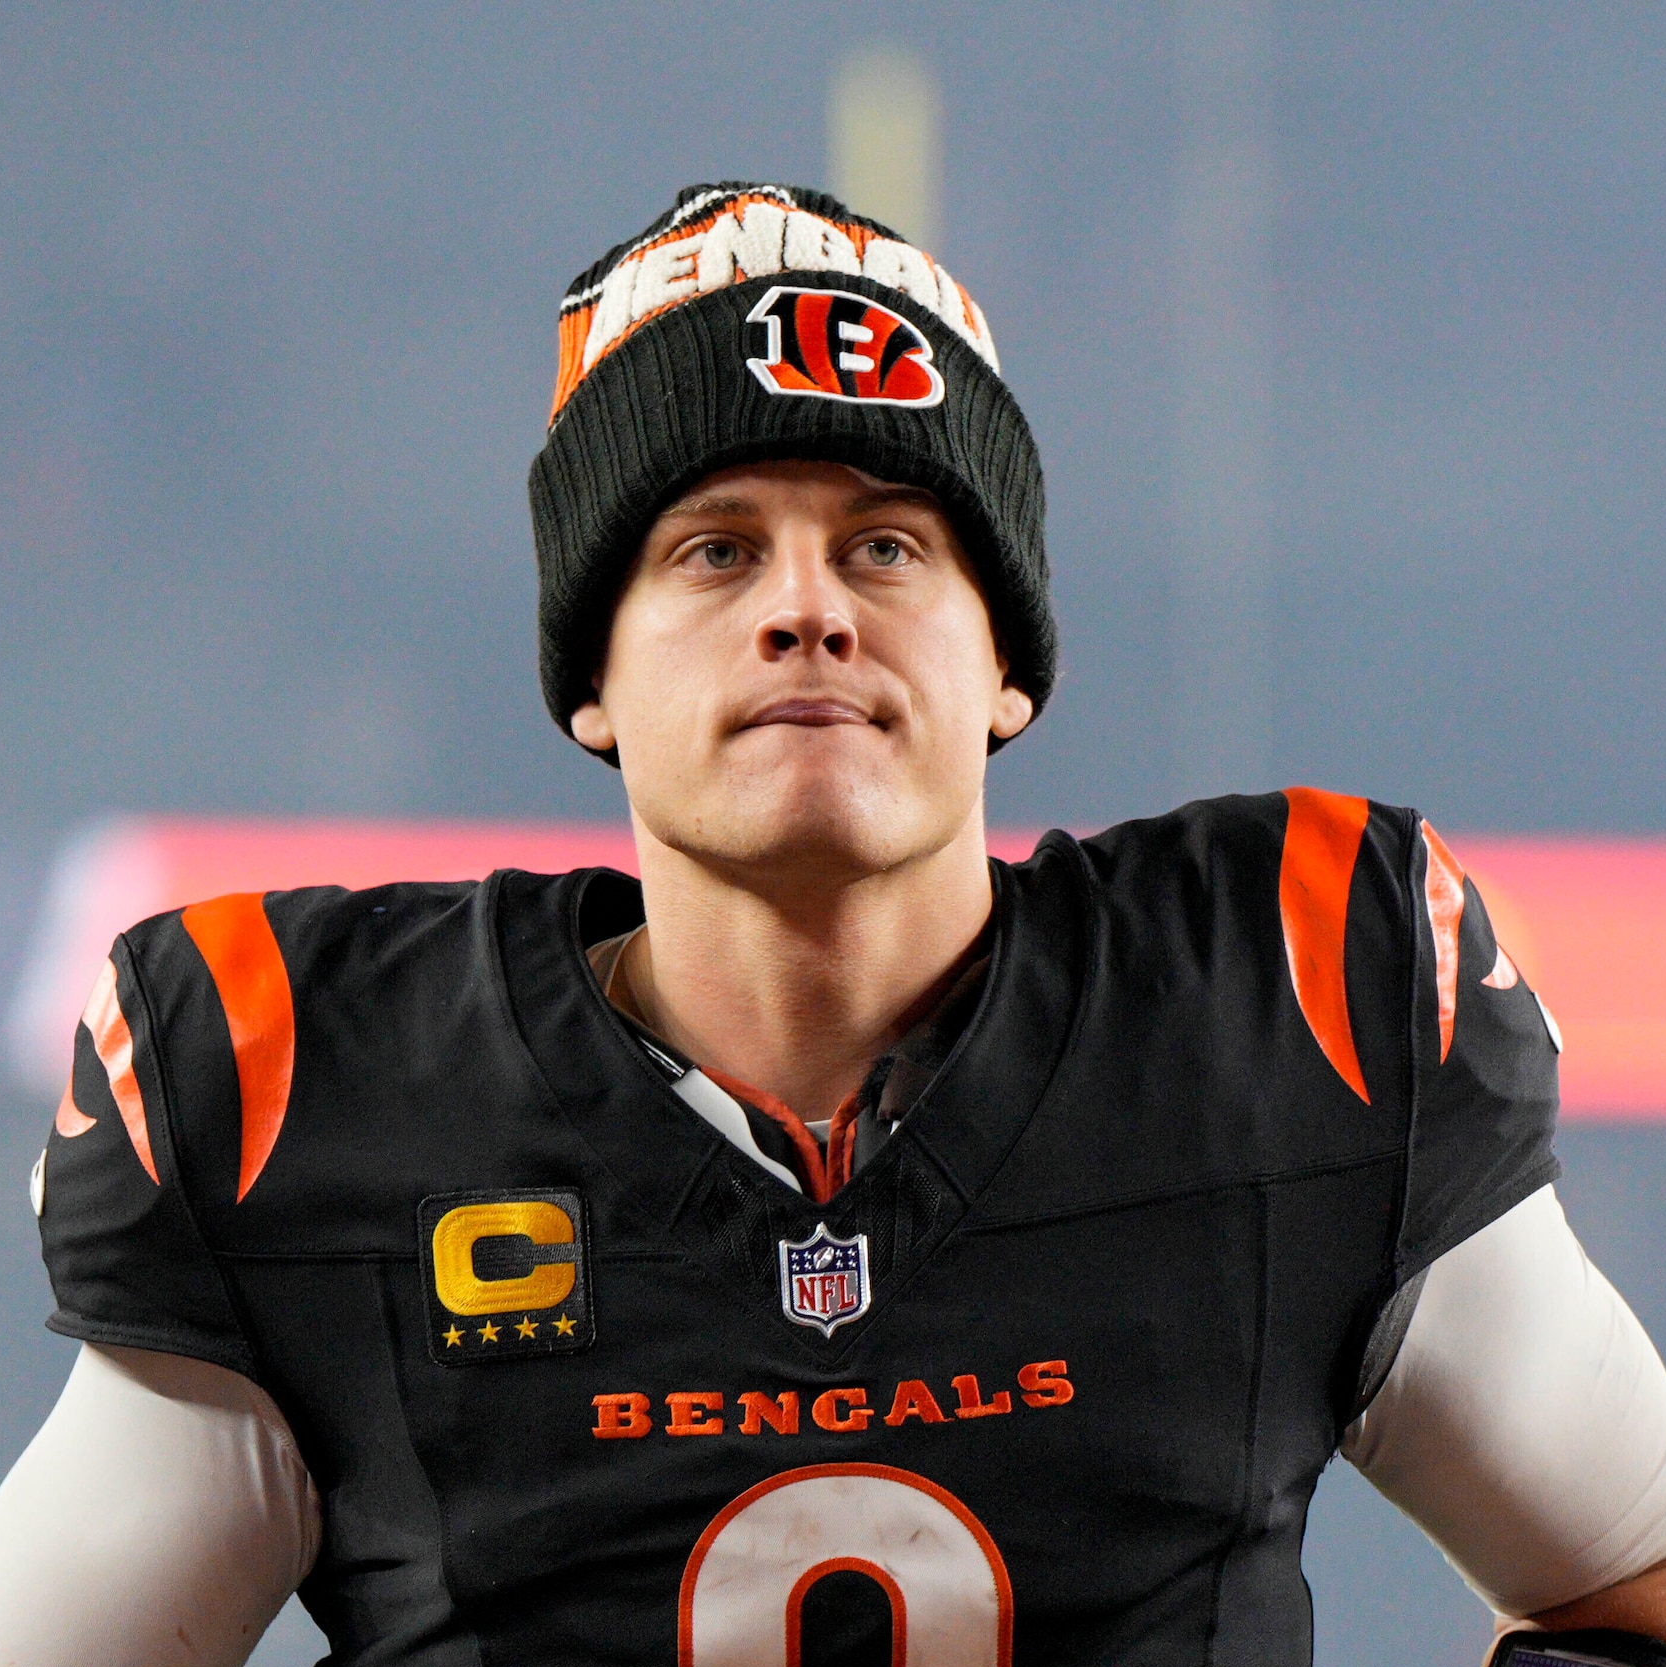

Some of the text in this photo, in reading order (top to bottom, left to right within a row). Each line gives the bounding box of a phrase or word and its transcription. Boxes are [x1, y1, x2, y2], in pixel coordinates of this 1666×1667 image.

[432, 1200, 576, 1317] C
[796, 1274, 855, 1315] NFL
[591, 1360, 1075, 1439] BENGALS
